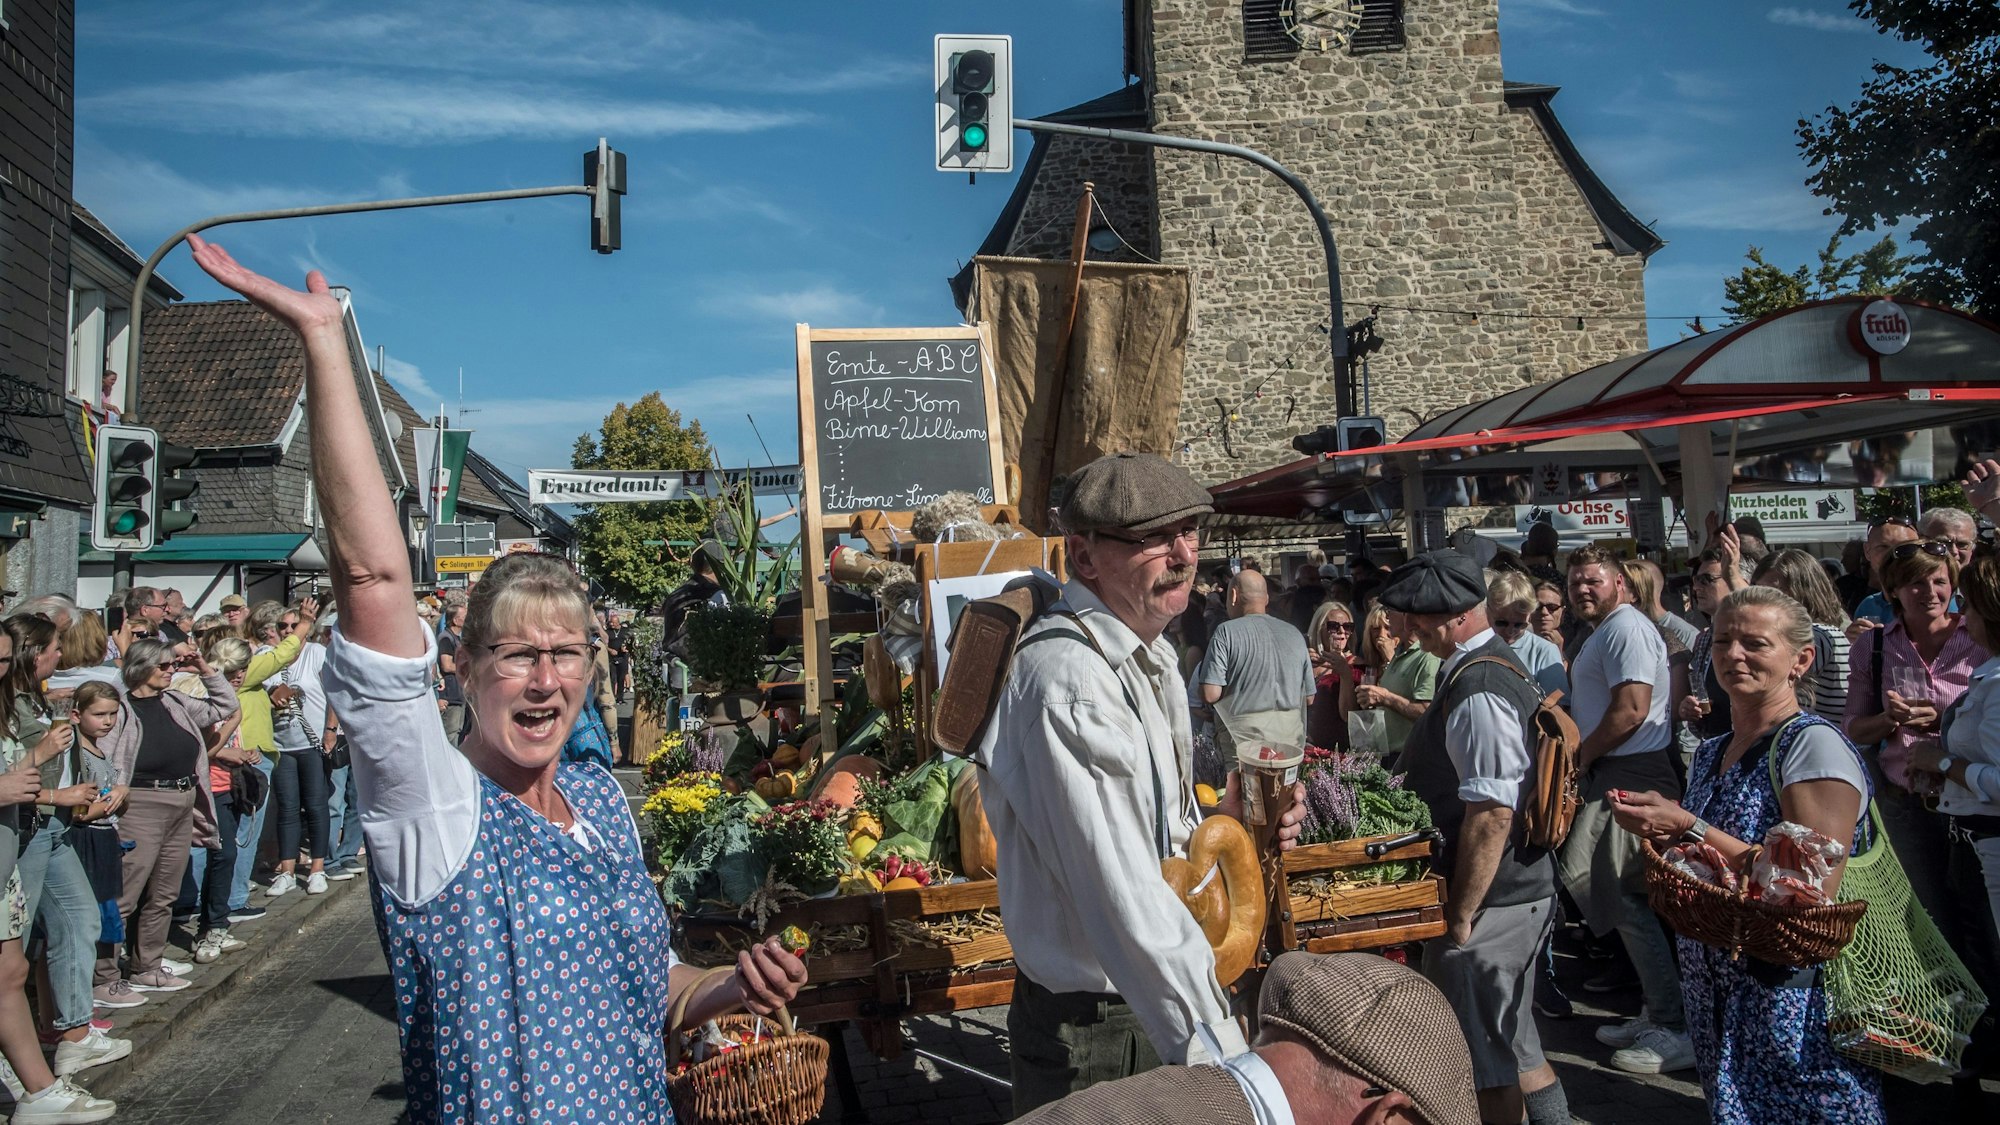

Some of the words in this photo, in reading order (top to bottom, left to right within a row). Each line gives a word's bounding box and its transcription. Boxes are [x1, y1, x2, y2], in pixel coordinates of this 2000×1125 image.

[1865, 313, 1907, 336] früh
[540, 475, 668, 495] Erntedank
[1558, 499, 1613, 515] Ochse
[1731, 507, 1808, 520] rntedank
[1582, 514, 1609, 525] am
[449, 561, 475, 570] Solingen
